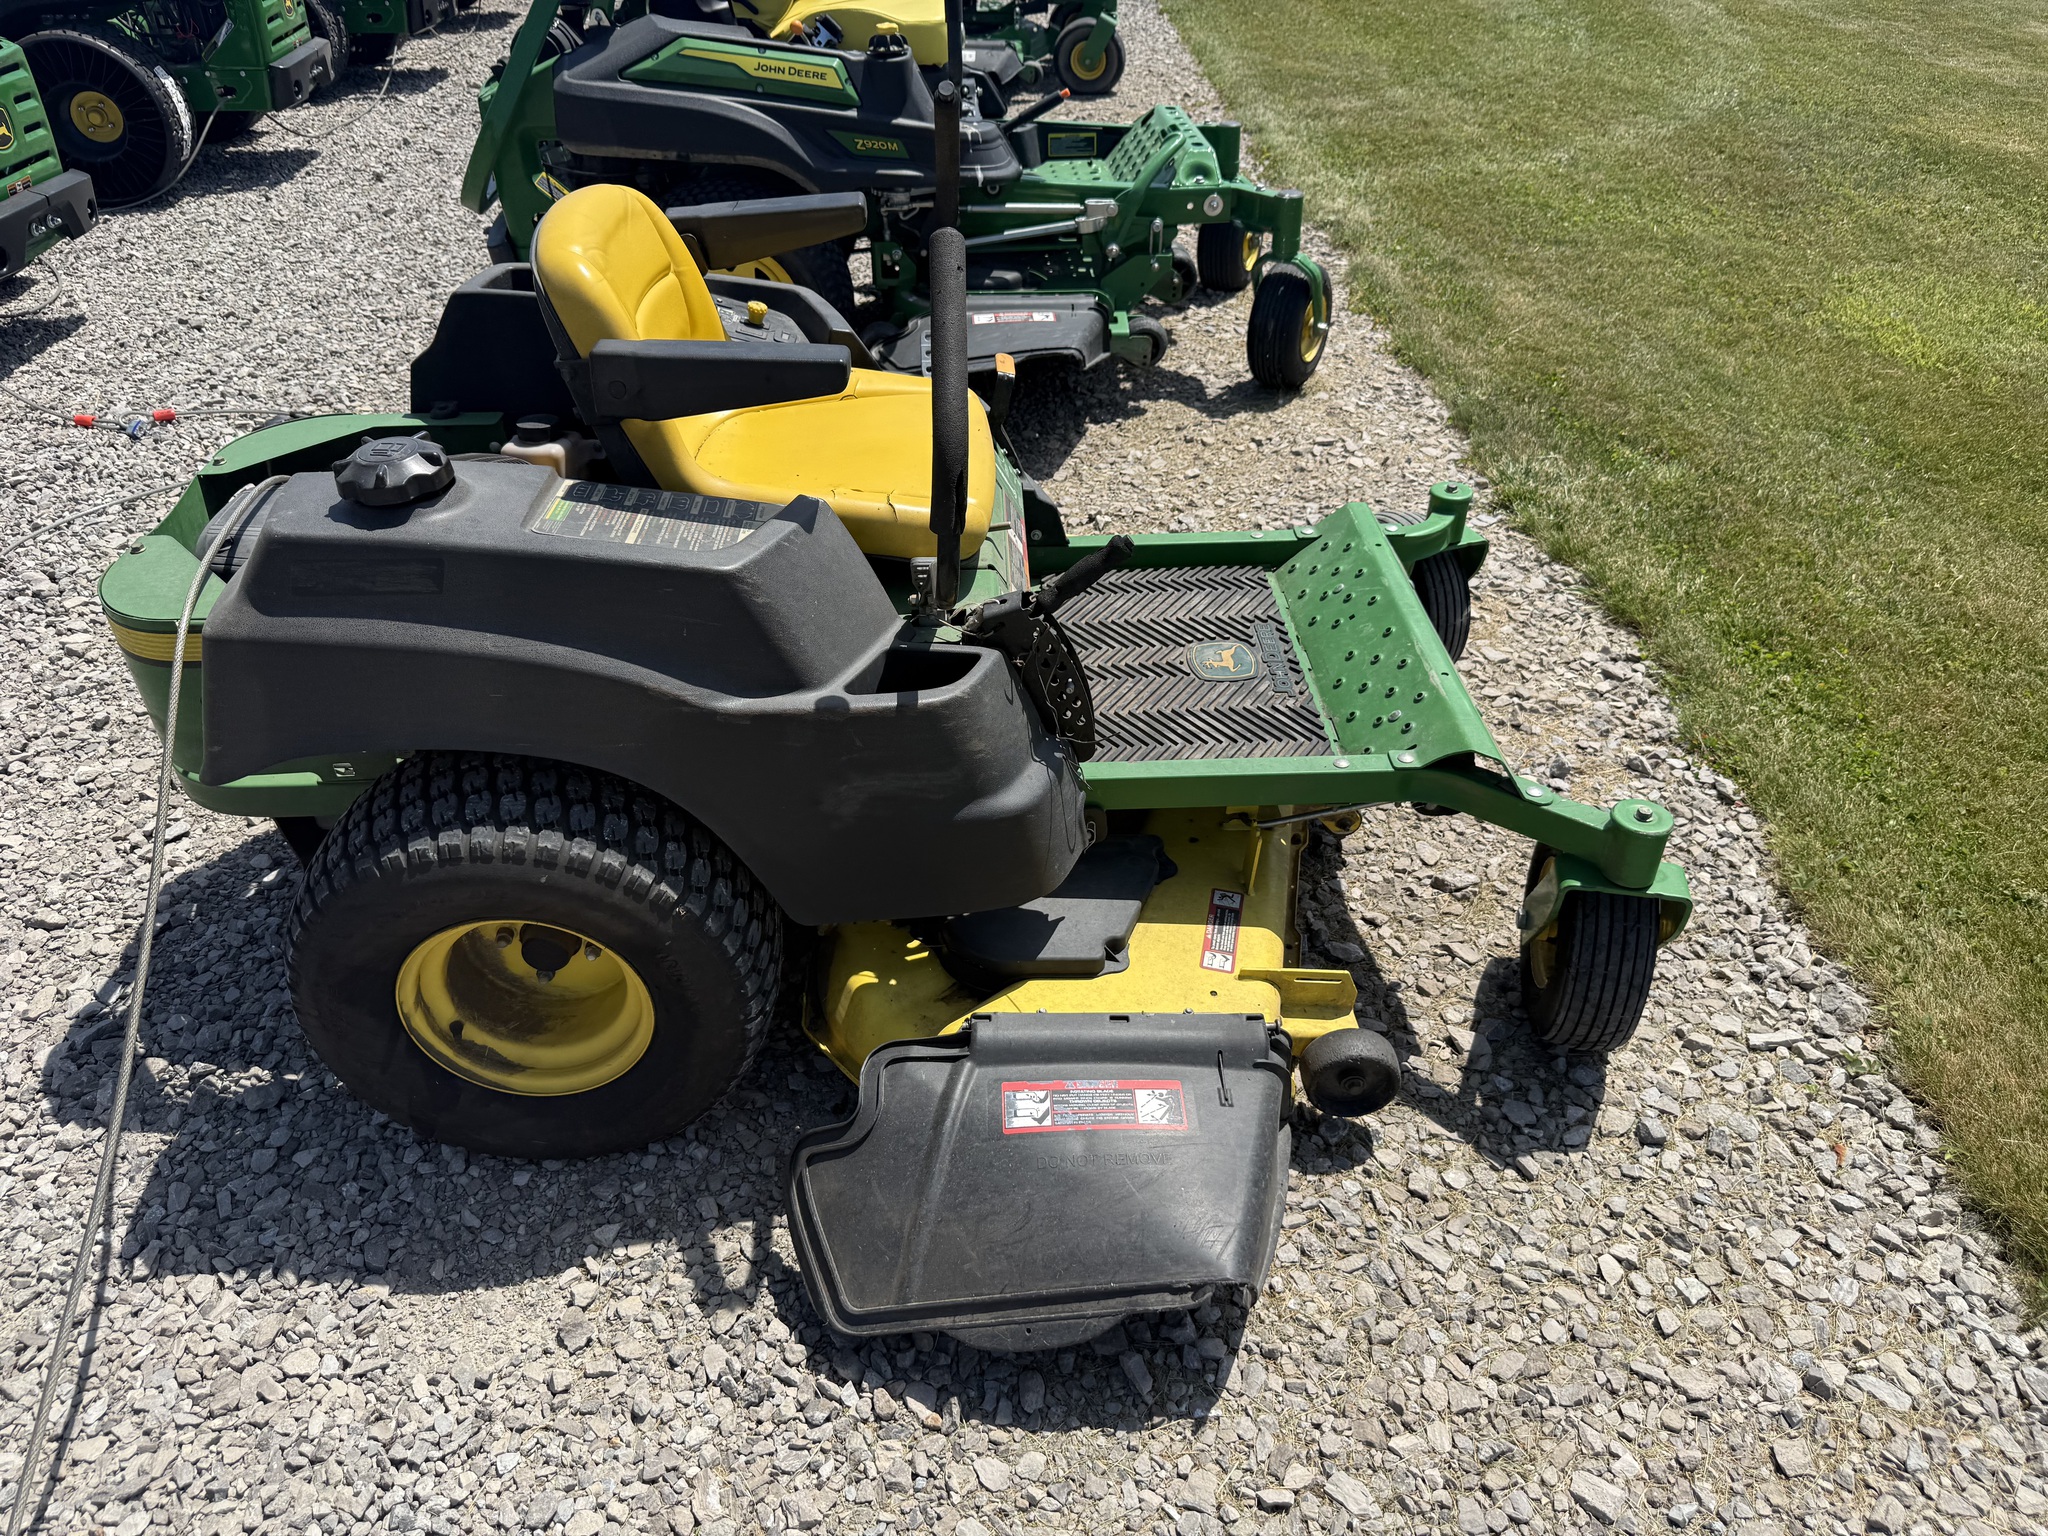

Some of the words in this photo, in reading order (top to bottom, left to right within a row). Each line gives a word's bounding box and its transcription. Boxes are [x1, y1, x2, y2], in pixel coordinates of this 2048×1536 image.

[754, 62, 785, 75] JOHN
[788, 66, 827, 80] DEERE
[854, 139, 899, 151] Z920M
[1258, 624, 1280, 660] DEERE
[1273, 662, 1295, 696] JOHN
[1206, 914, 1214, 934] DANGER
[1037, 1156, 1059, 1170] DO
[1065, 1154, 1100, 1168] NOT
[1103, 1152, 1173, 1166] REMOVE
